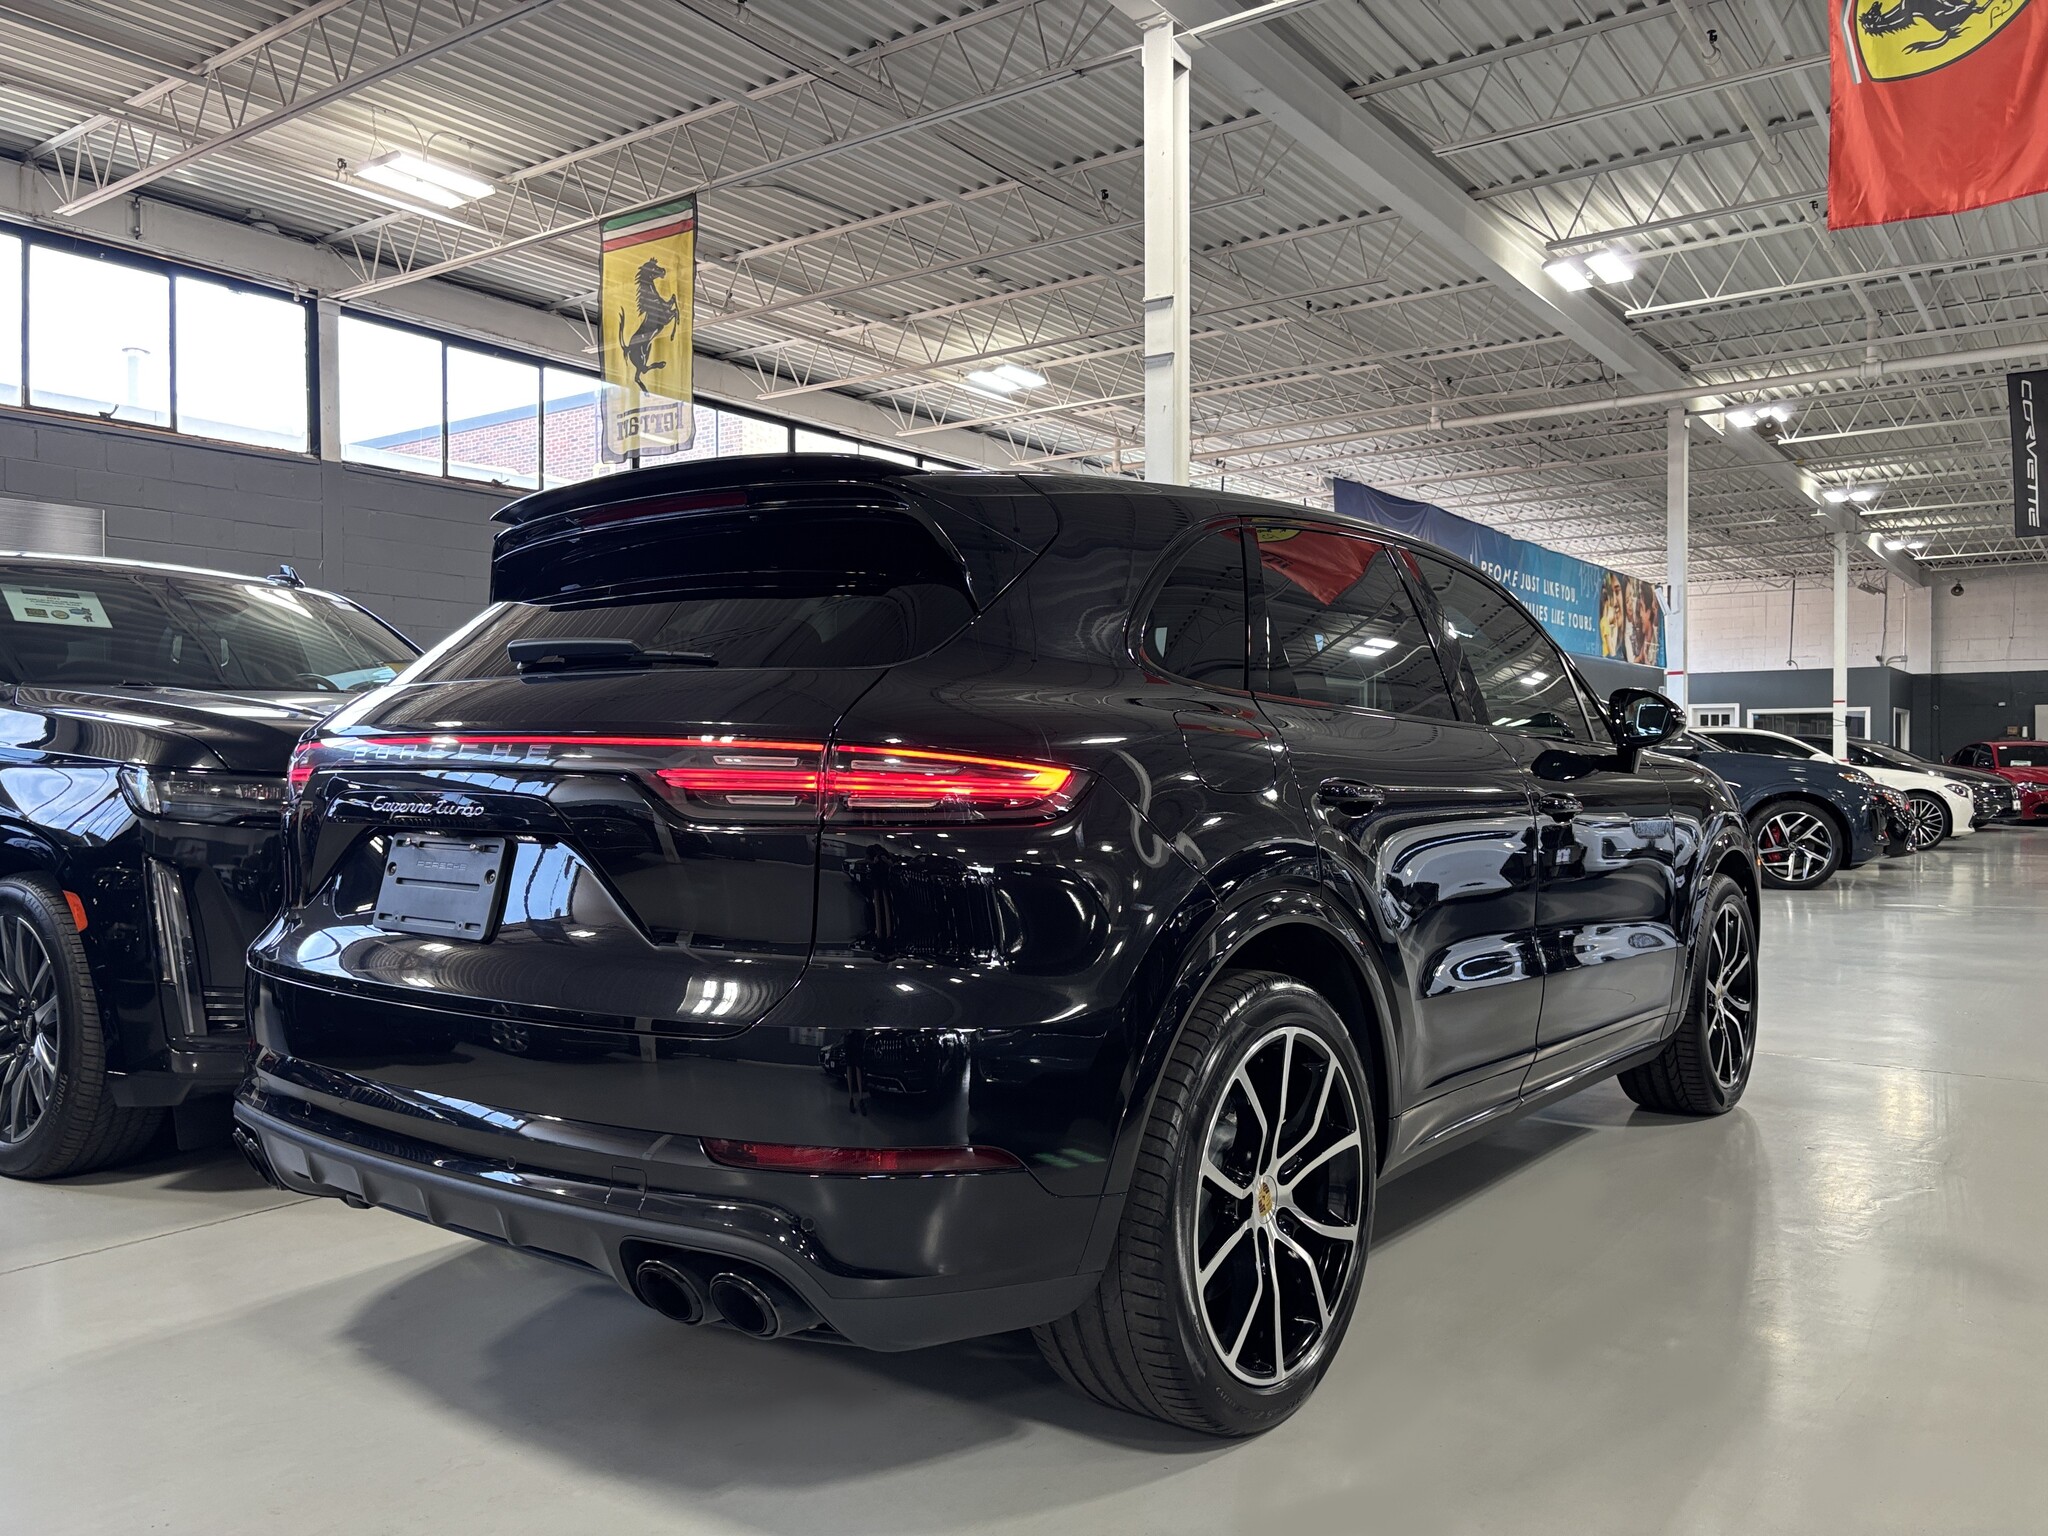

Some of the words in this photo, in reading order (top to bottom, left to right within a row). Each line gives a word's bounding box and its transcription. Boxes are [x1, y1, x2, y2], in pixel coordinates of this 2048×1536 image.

[2020, 379, 2041, 528] CORVETTE
[1520, 573, 1540, 593] JUST
[1543, 579, 1559, 598] LIKE
[1551, 607, 1565, 626] LIKE
[1568, 612, 1595, 632] YOURS.
[353, 744, 552, 760] PORSCHE
[371, 795, 432, 819] Cayenne
[416, 860, 467, 871] PORSCHE
